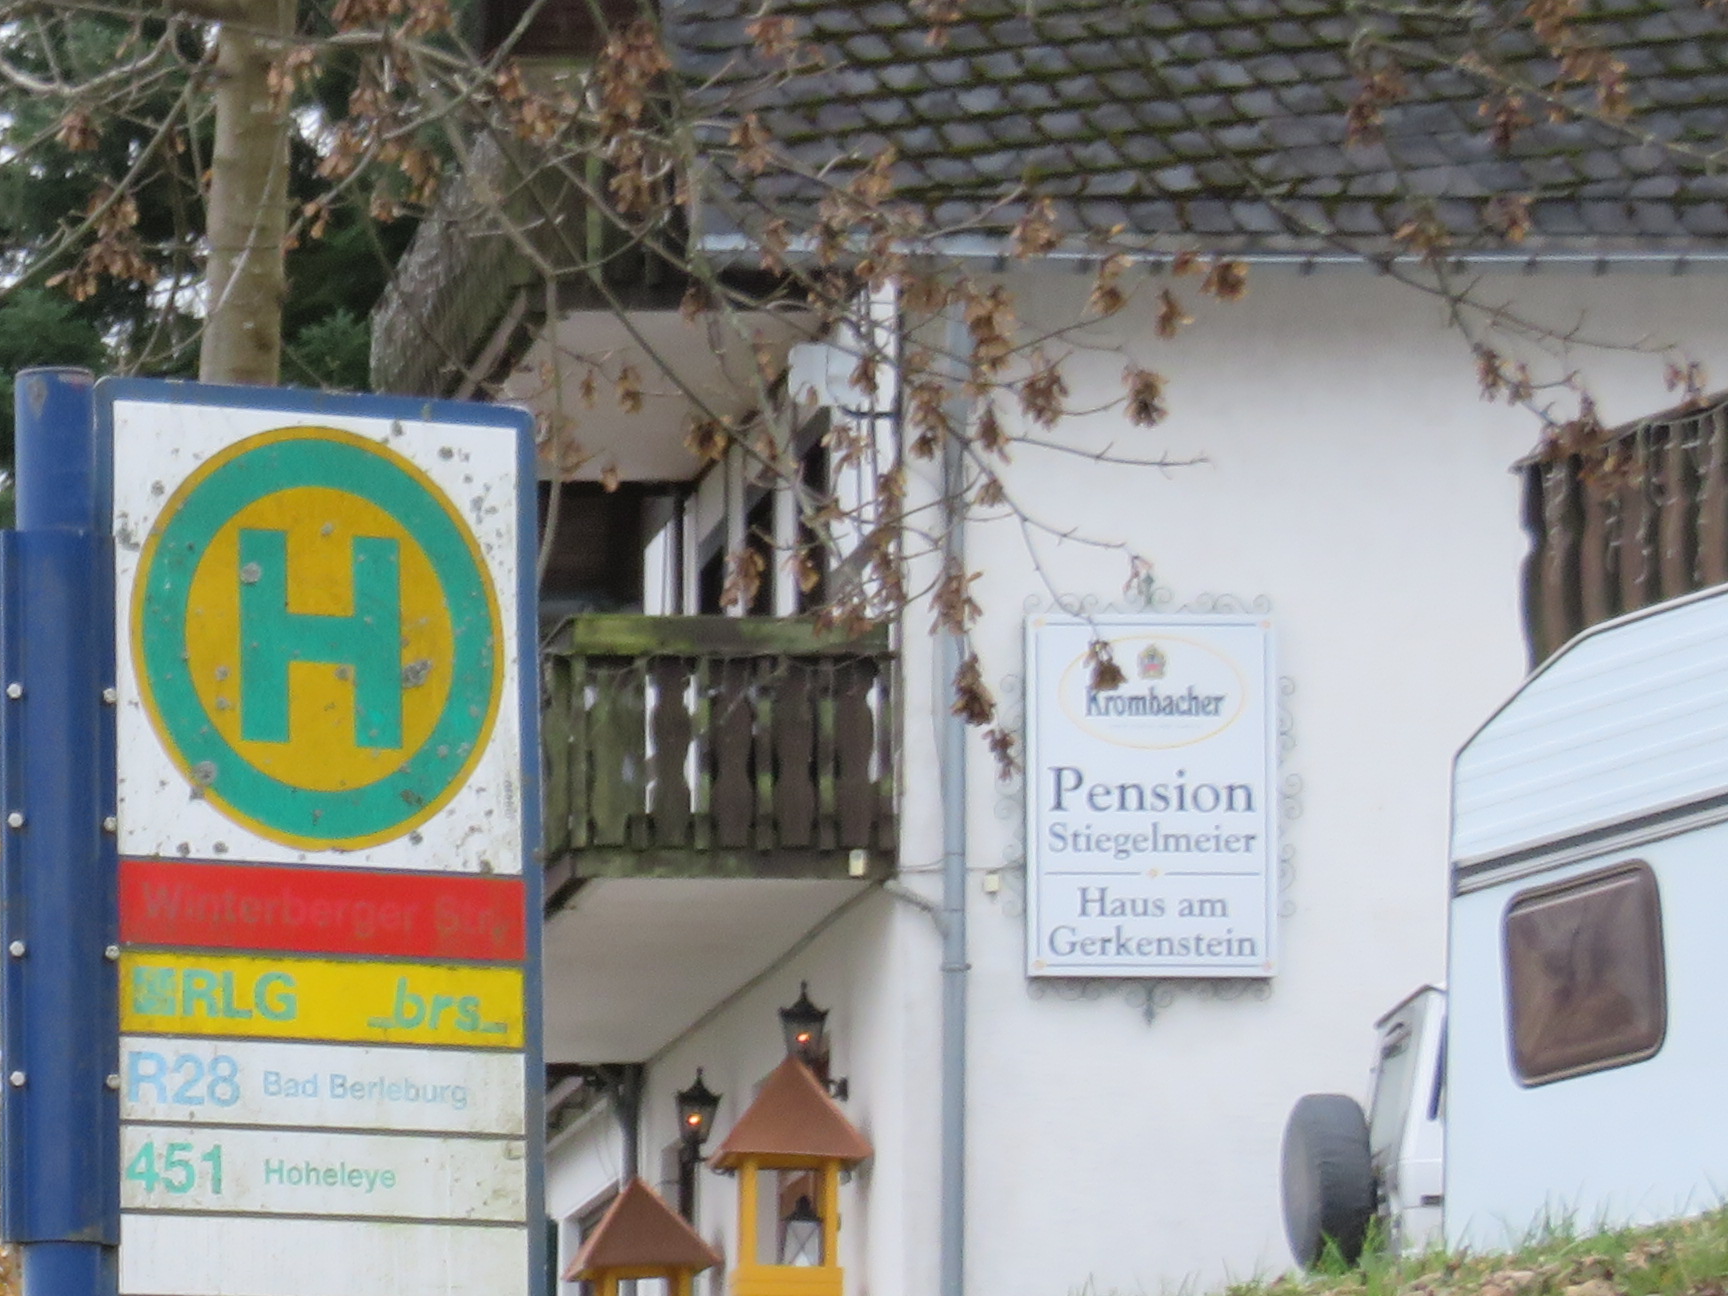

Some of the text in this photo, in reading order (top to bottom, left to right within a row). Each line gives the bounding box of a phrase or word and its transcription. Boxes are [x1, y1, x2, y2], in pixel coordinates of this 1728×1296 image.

[238, 528, 402, 750] H
[1084, 685, 1226, 717] Krombacher
[1047, 766, 1257, 813] Pension
[1047, 822, 1257, 860] Stiegelmeier
[139, 880, 417, 940] Winterberger
[1076, 885, 1229, 919] Haus am
[1047, 924, 1257, 958] Gerkenstein
[127, 1051, 468, 1110] R28 Bad Berleburg
[125, 1141, 397, 1196] 451 Hoheleye
